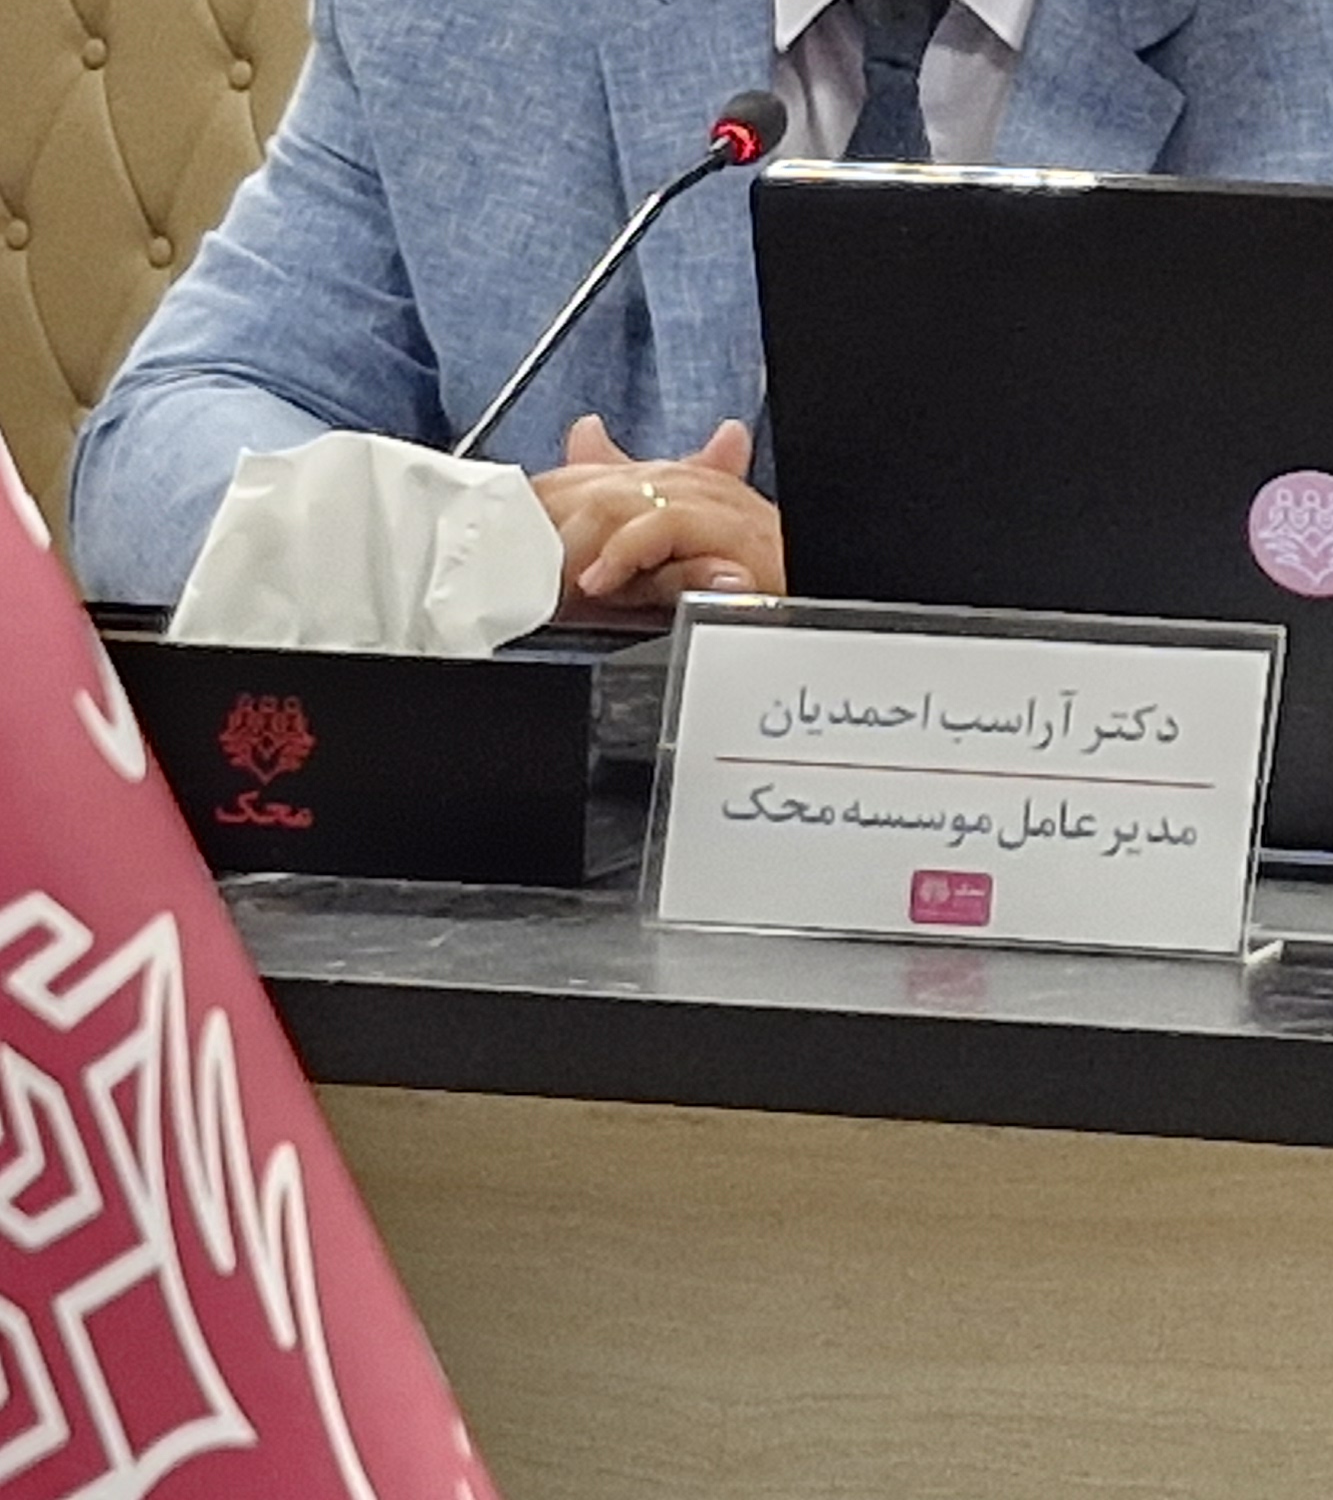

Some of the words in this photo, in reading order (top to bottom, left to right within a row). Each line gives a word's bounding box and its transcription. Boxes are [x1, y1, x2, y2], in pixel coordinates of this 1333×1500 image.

[758, 686, 932, 739] احمدیان
[938, 688, 1077, 752] آراسب
[1080, 703, 1180, 756] دکتر
[214, 790, 313, 828] محک
[721, 784, 837, 827] محک
[996, 798, 1098, 852] عامل
[1100, 817, 1198, 858] مدیر
